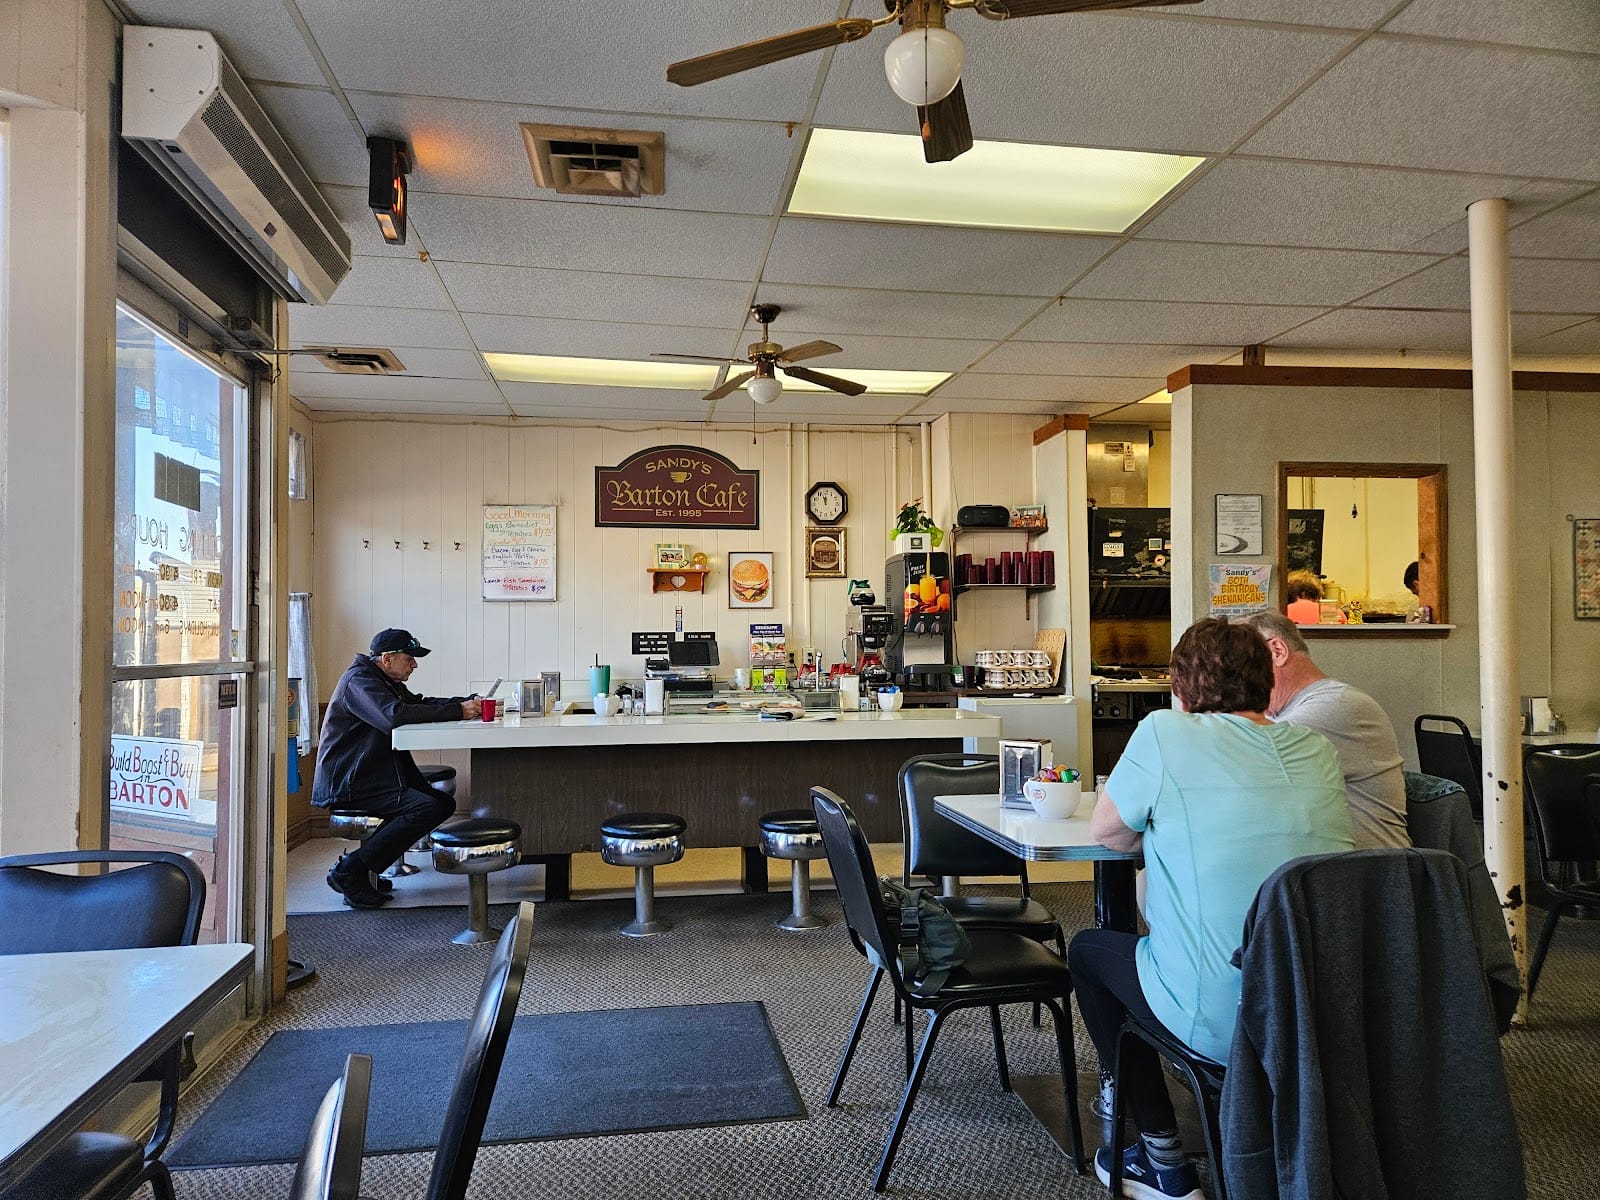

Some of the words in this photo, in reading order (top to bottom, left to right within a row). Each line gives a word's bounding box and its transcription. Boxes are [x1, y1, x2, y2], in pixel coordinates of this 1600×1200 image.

[645, 457, 712, 476] SANDY'S
[606, 480, 691, 506] Barton
[696, 481, 750, 515] Cafe
[484, 507, 511, 521] Good
[514, 509, 551, 525] Morning
[678, 509, 702, 519] 1995
[485, 522, 503, 533] Eggs
[1225, 569, 1257, 577] Sandy's
[1221, 584, 1260, 593] BIRTHDAY
[1212, 592, 1266, 605] SHENANIGANS
[133, 745, 163, 776] Boost
[171, 749, 193, 786] Buy
[110, 780, 190, 810] BARTON
